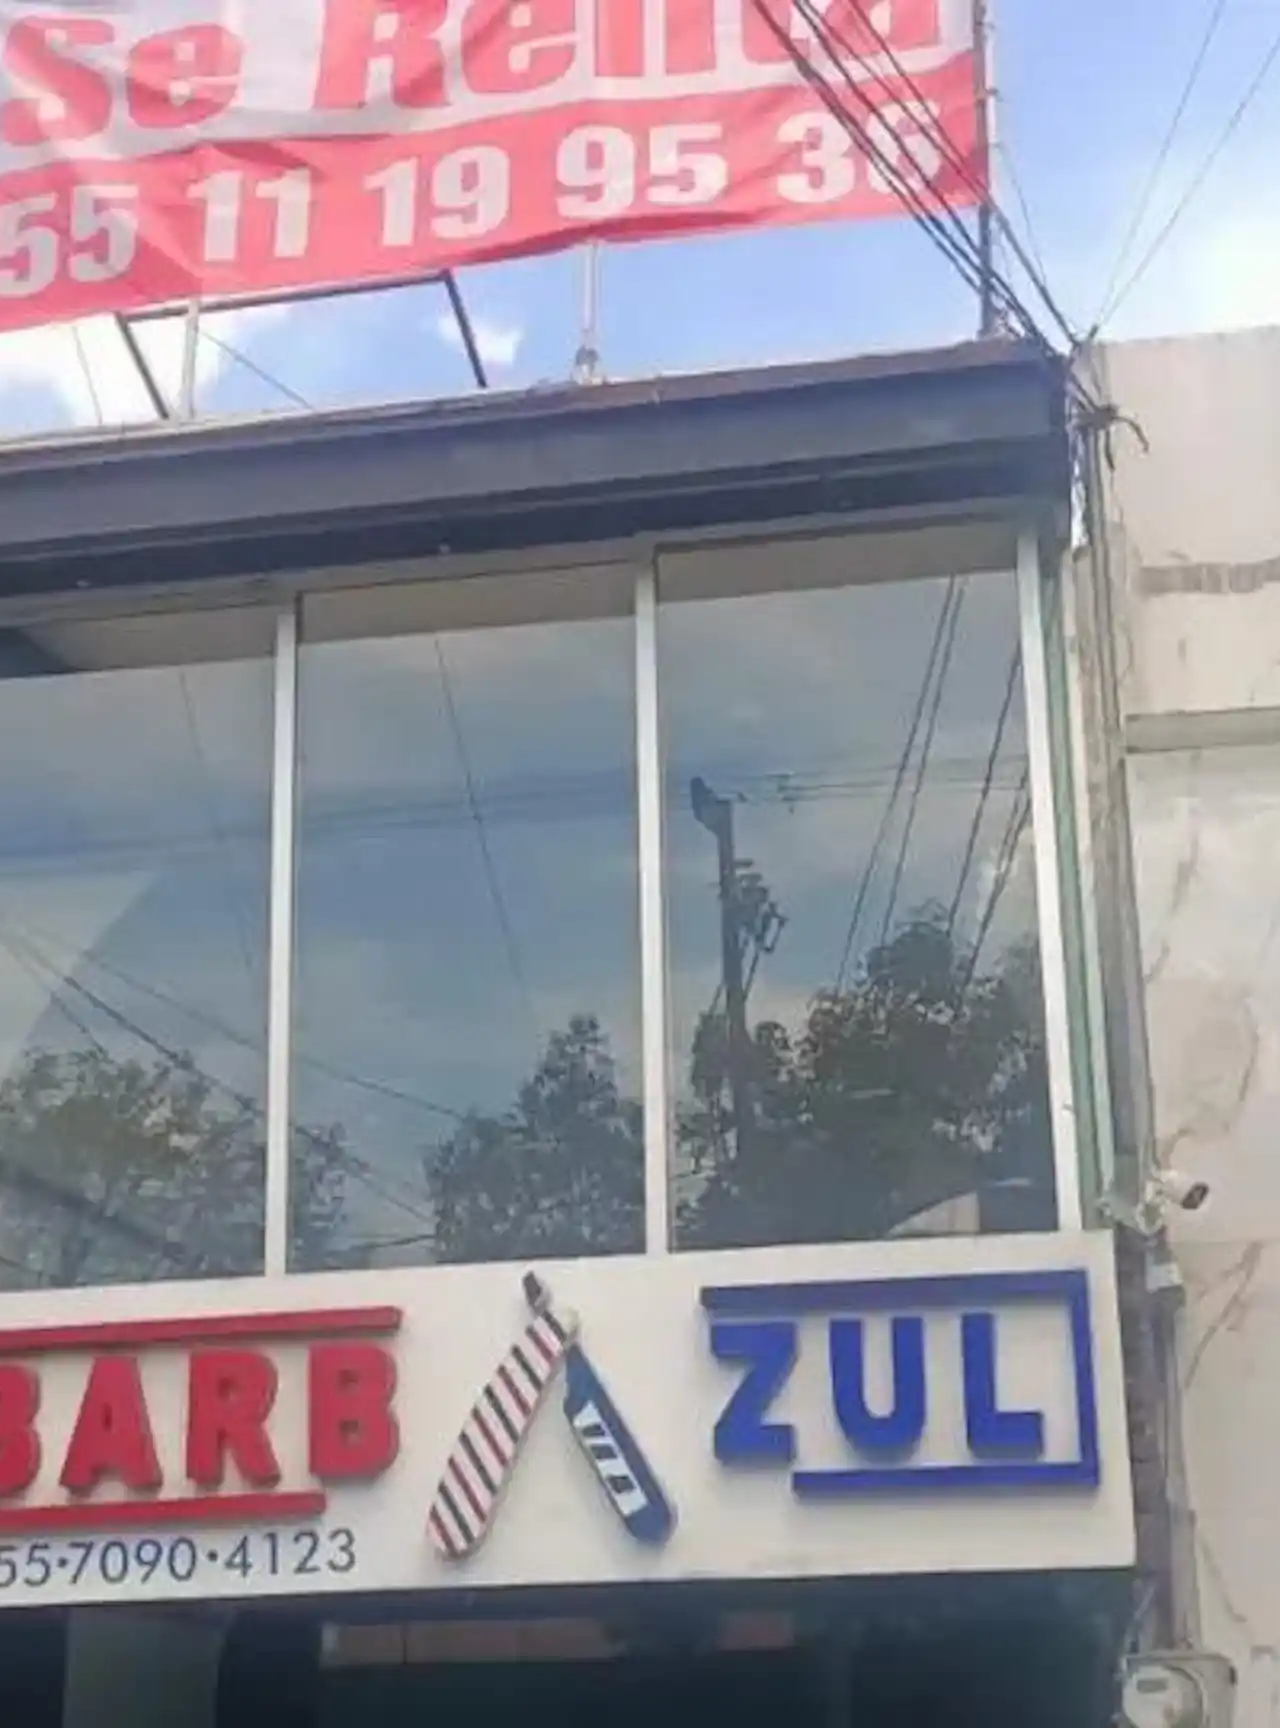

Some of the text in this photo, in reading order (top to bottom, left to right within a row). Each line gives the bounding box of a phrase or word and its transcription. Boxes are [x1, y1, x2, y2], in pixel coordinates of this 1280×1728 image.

[186, 168, 312, 263] 11
[364, 146, 509, 244] 19
[555, 122, 729, 220] 95
[776, 100, 943, 203] 36
